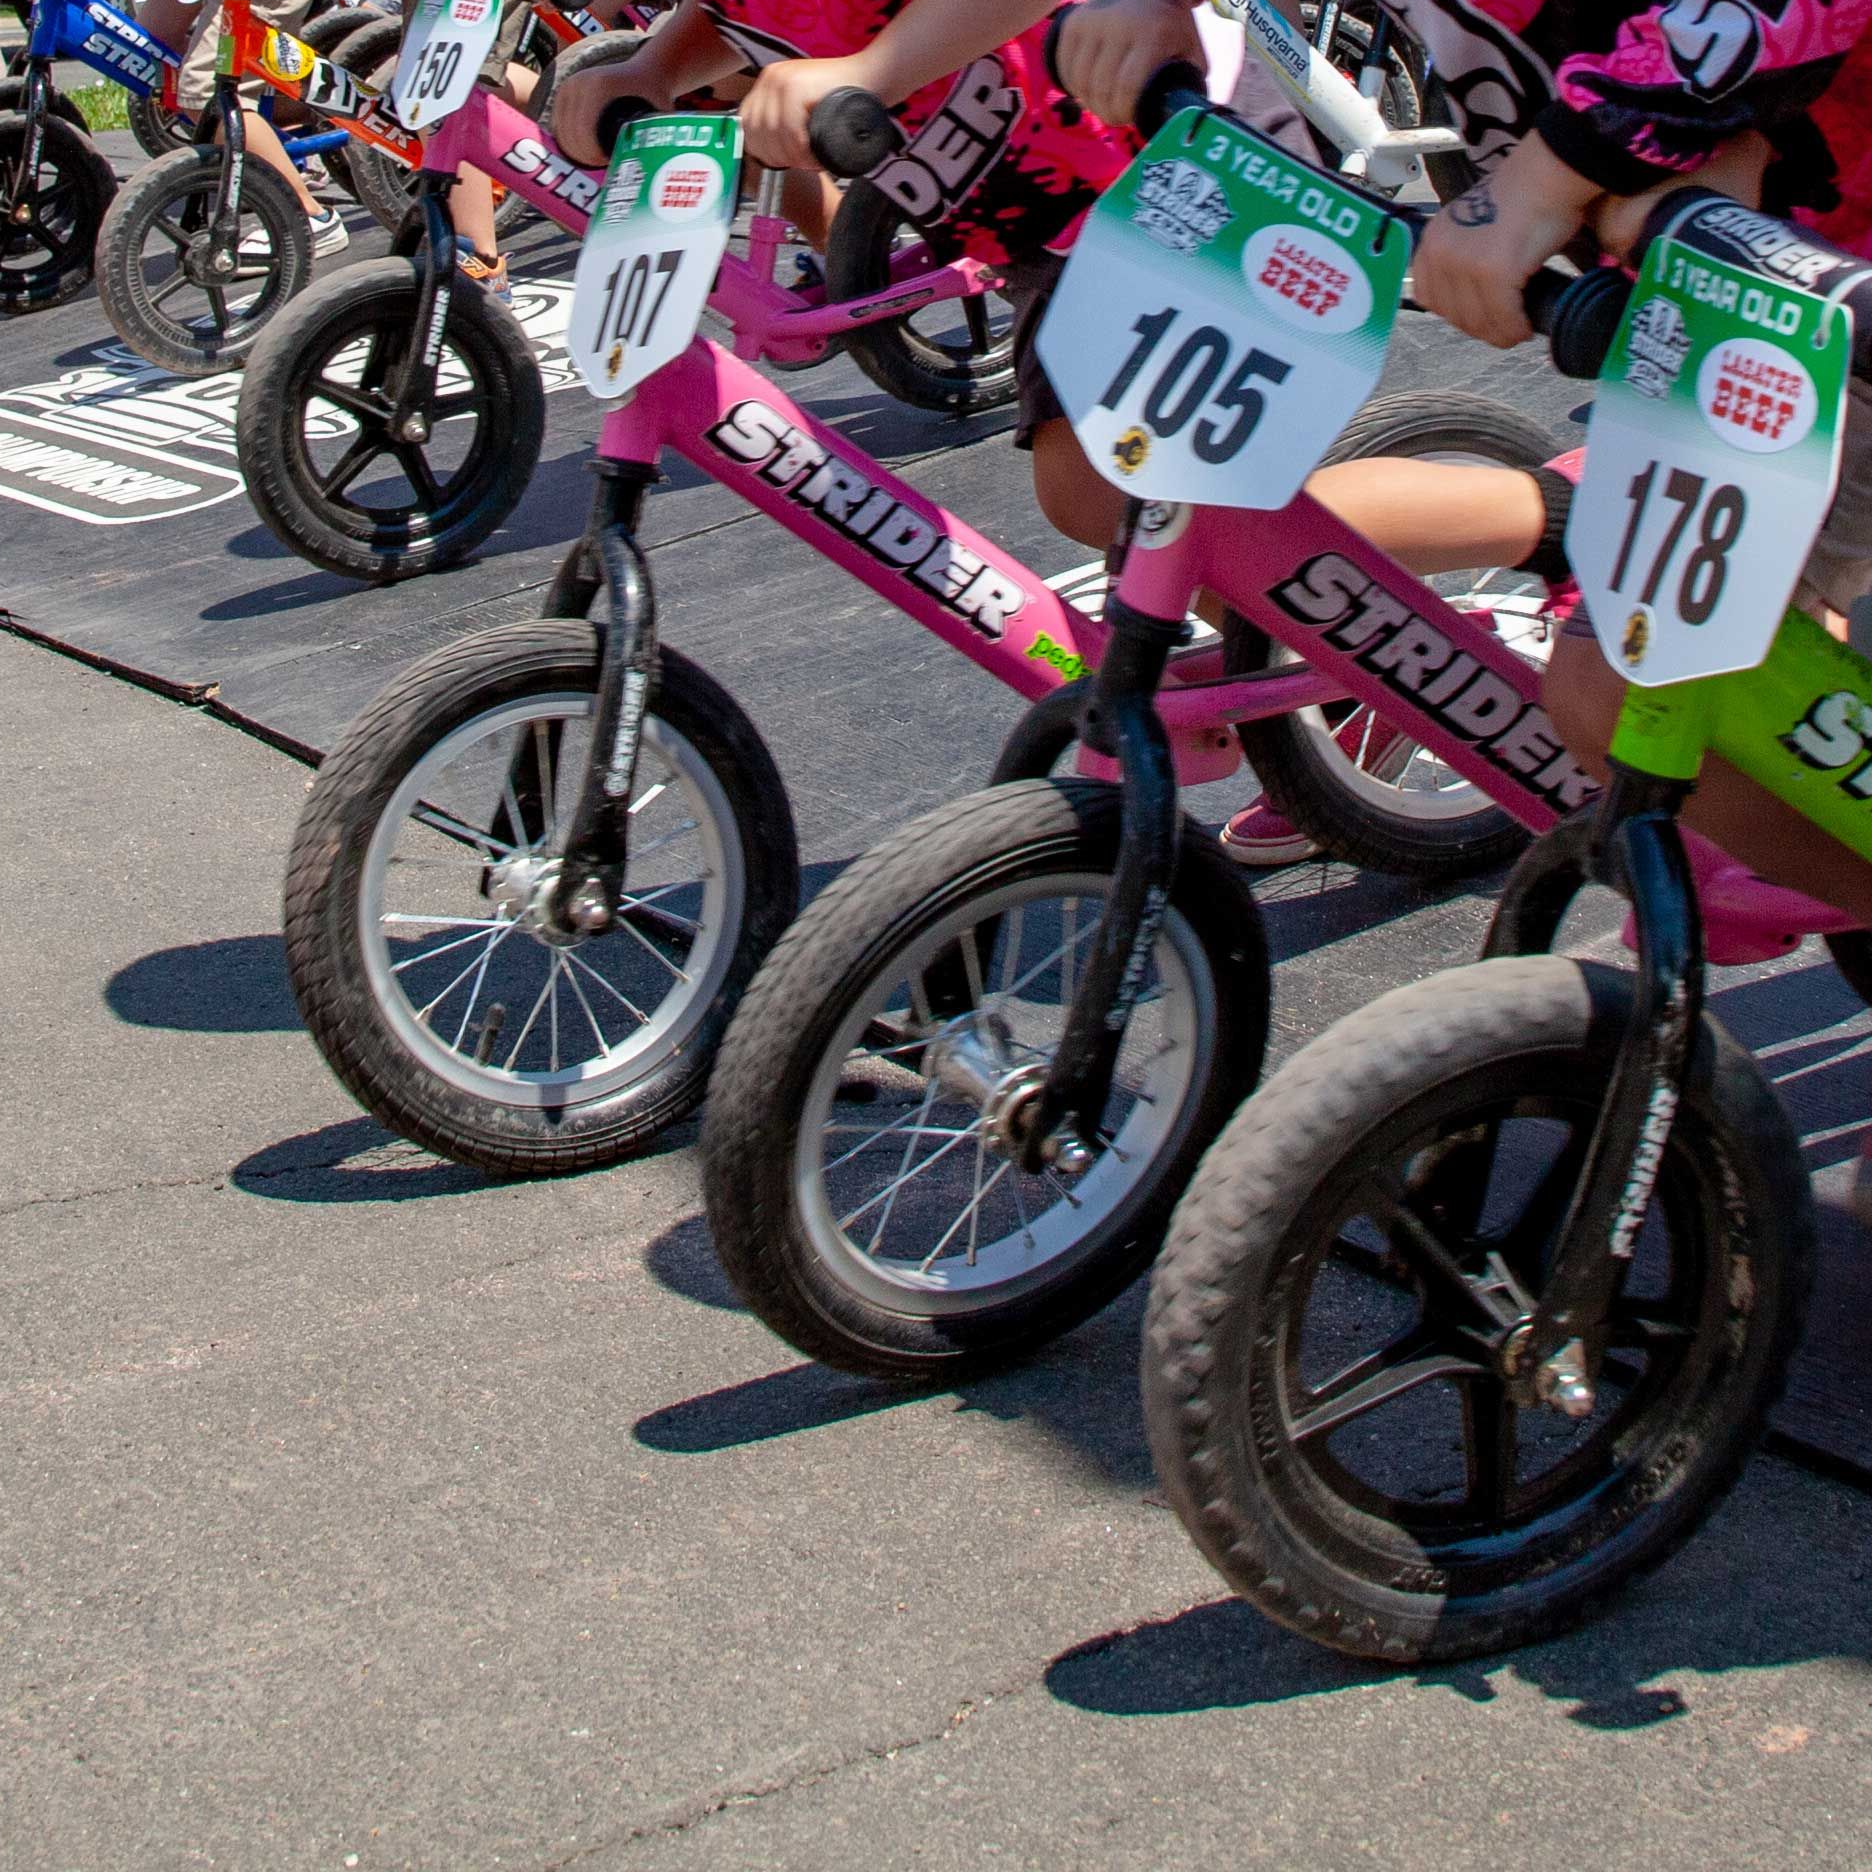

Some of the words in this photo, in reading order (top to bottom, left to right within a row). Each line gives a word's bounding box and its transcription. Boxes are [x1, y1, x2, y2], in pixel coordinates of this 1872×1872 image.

[406, 41, 464, 101] 150
[1245, 0, 1308, 72] Husqvarna
[675, 125, 714, 147] OLD
[1205, 135, 1229, 162] 3
[1232, 150, 1302, 202] YEAR
[1297, 187, 1361, 238] OLD
[1695, 203, 1842, 290] STRIDER
[425, 287, 451, 367] STRIDER
[592, 249, 686, 354] 107
[1257, 257, 1344, 318] BEEF
[1669, 257, 1685, 290] 3
[1685, 266, 1741, 312] YEAR
[1740, 287, 1803, 337] OLD
[1099, 306, 1295, 464] 105
[1710, 377, 1797, 441] BEEF
[1720, 348, 1803, 399] LASATER
[704, 399, 1028, 643] STRIDER
[1606, 459, 1747, 627] 178
[1267, 551, 1604, 816] STRIDER
